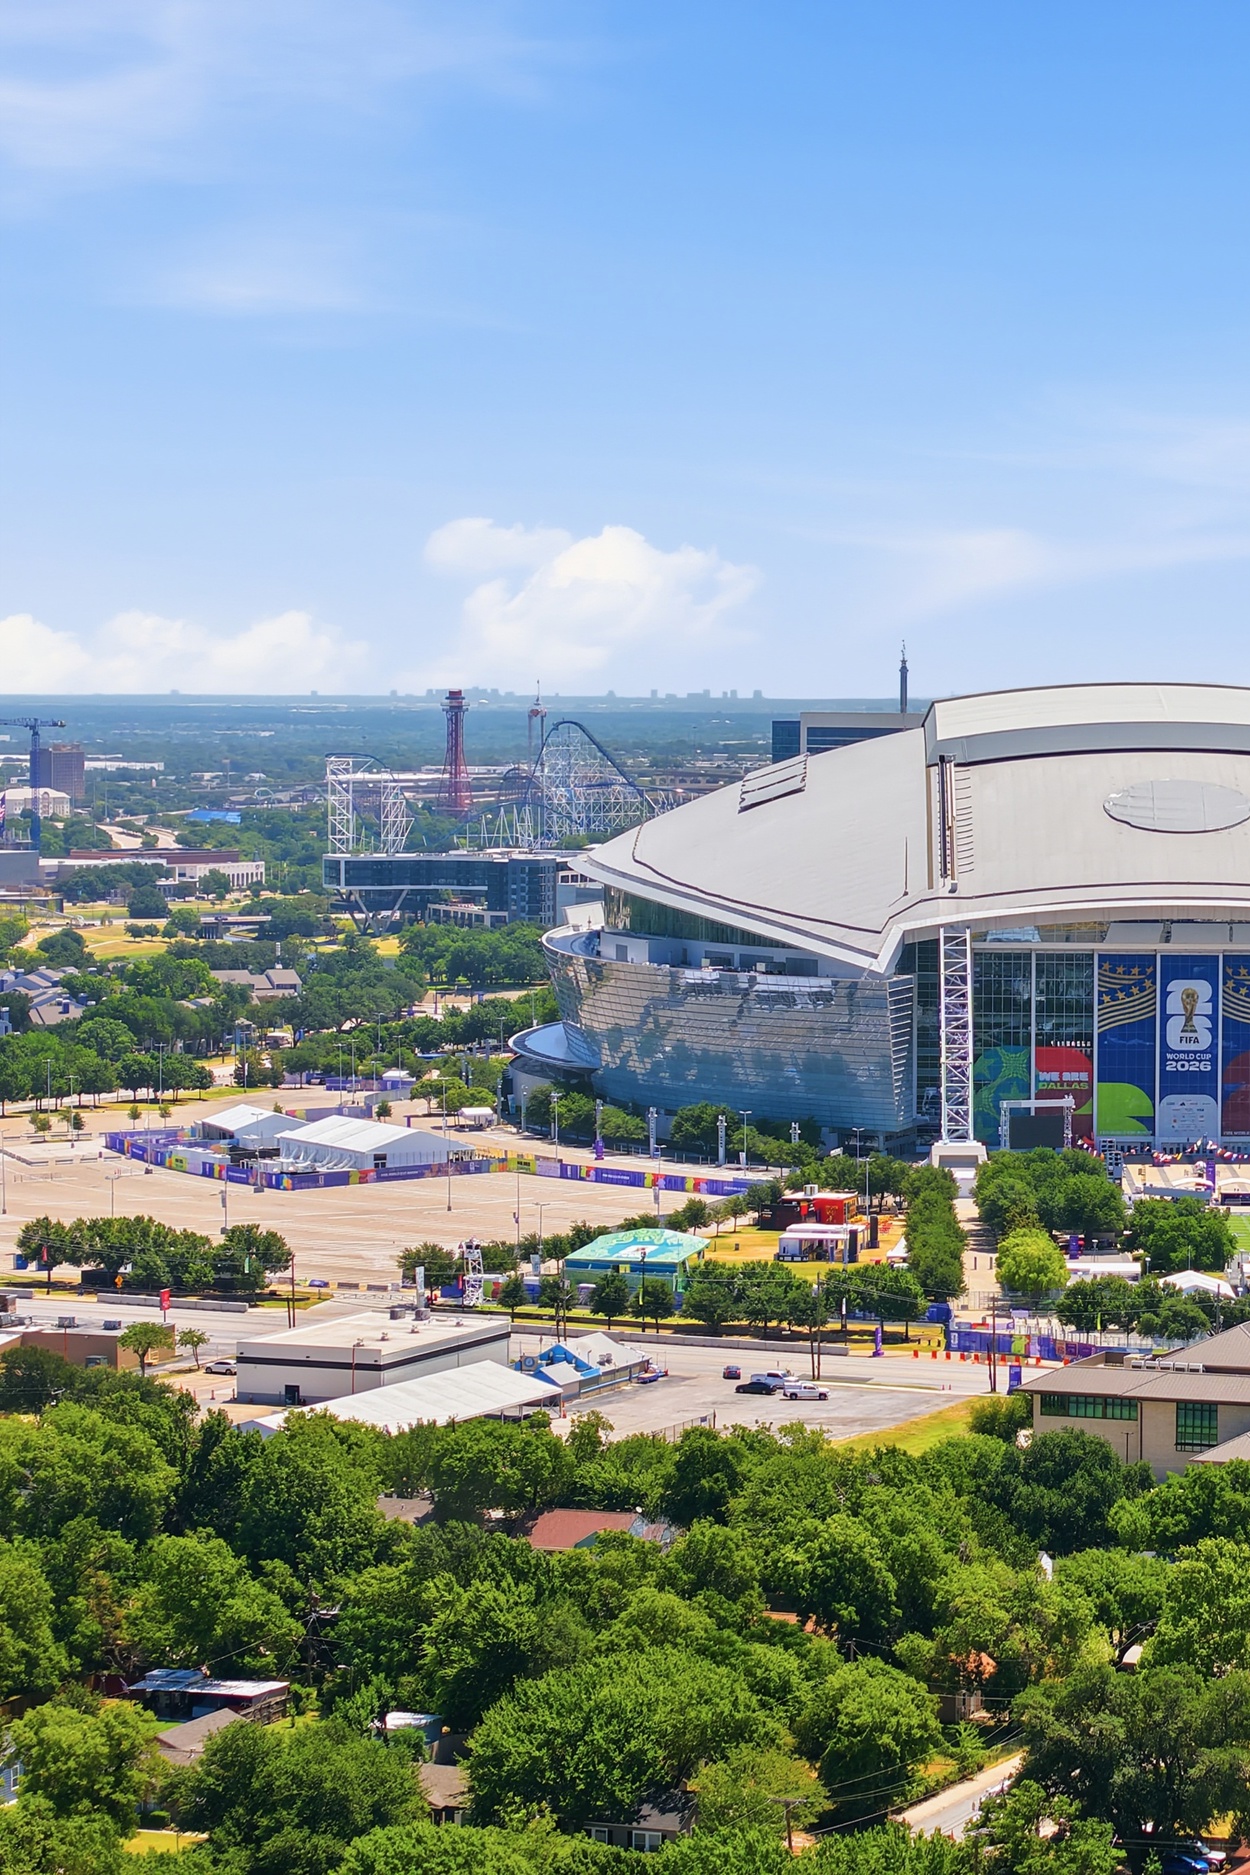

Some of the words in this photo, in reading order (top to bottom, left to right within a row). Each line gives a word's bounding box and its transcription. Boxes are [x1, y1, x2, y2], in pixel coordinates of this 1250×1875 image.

[1179, 1036, 1200, 1044] FIFA
[1165, 1060, 1212, 1071] 2026
[1039, 1071, 1060, 1081] WE
[1062, 1071, 1089, 1081] ARE
[1038, 1082, 1089, 1090] DALLAS
